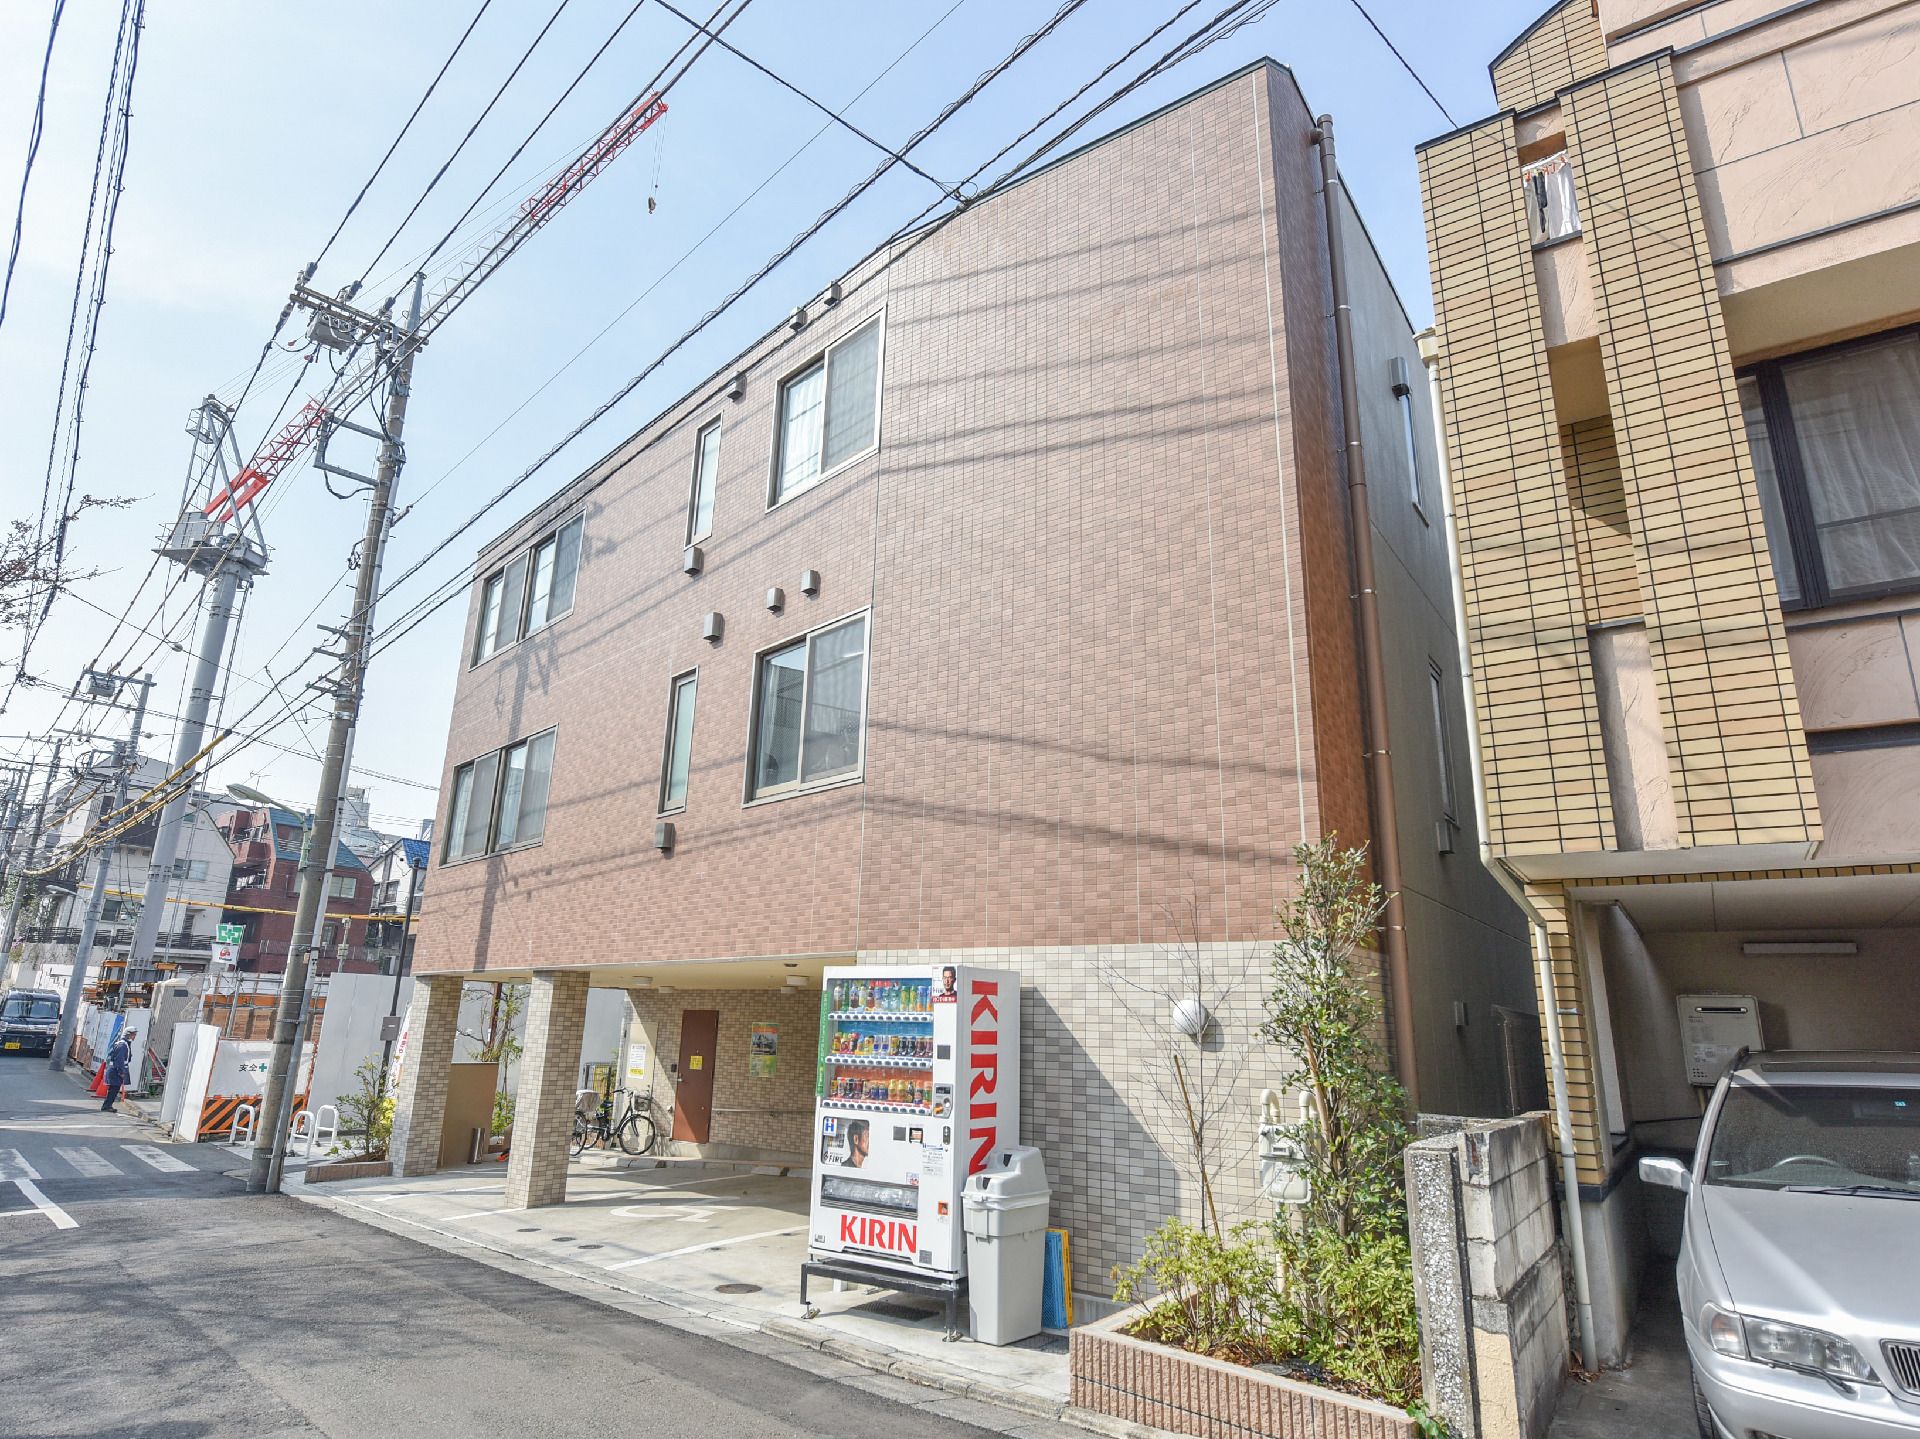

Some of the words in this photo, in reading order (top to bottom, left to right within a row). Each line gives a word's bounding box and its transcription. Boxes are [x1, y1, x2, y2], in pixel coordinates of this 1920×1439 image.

[238, 1063, 258, 1072] 安全
[969, 980, 998, 1176] KIRIN
[841, 1215, 917, 1253] KIRIN
